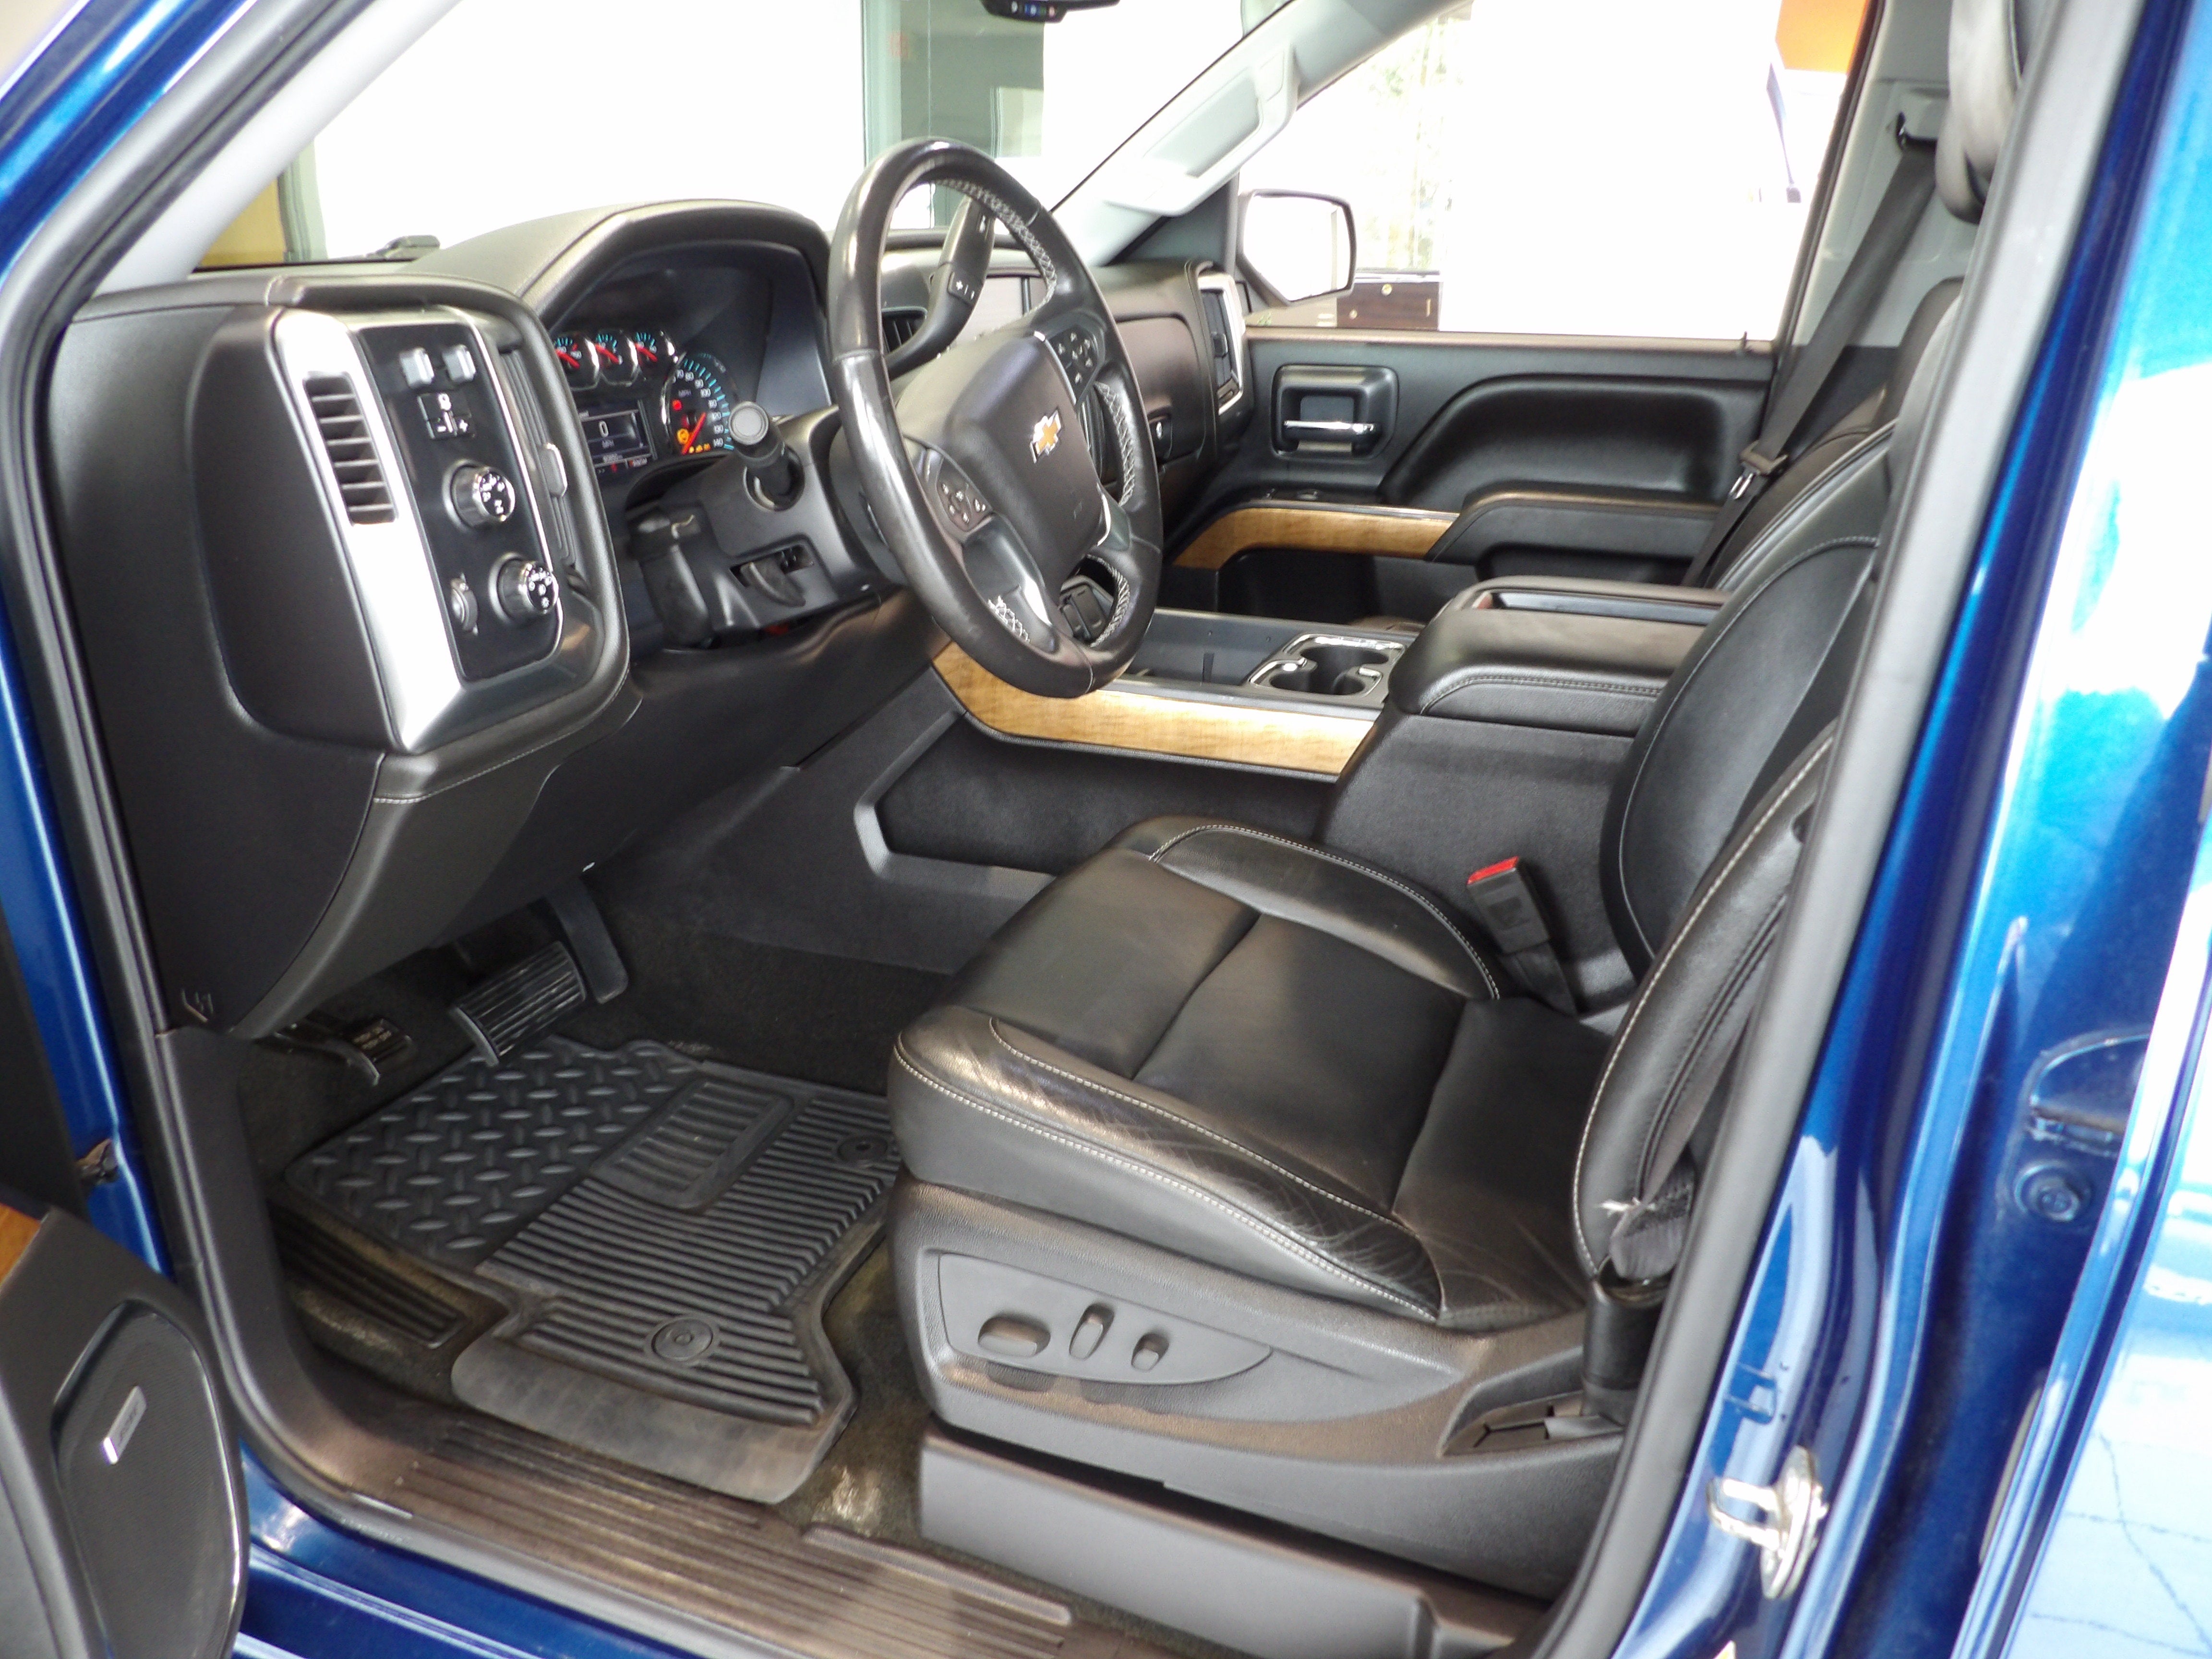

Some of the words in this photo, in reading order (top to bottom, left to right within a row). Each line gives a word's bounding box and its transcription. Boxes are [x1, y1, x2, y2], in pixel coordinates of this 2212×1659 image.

[695, 379, 704, 389] 90
[700, 388, 711, 397] 100
[711, 411, 721, 421] 120
[599, 421, 609, 438] 0
[713, 424, 723, 434] 130
[713, 437, 723, 448] 140
